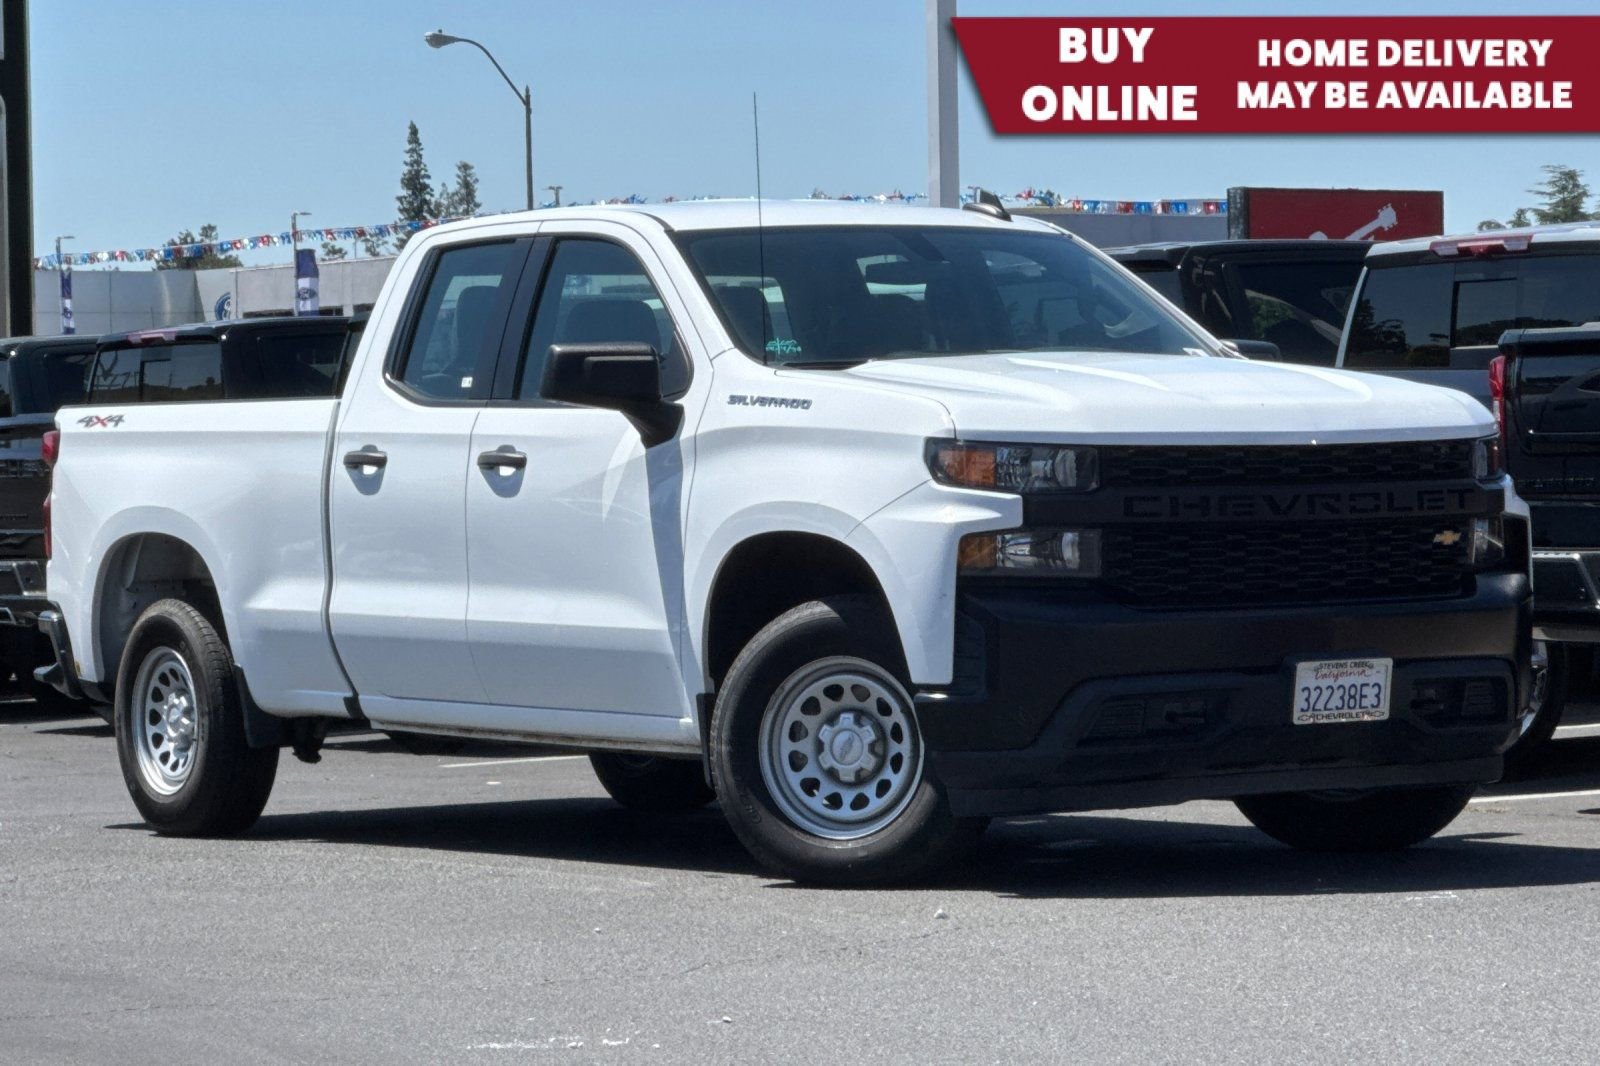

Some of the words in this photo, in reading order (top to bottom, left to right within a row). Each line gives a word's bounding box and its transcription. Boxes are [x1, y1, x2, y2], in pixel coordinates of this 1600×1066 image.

[727, 394, 813, 410] SILVERADO
[1123, 488, 1475, 517] CHEVROLET
[1318, 661, 1348, 670] STEVENS
[1314, 668, 1370, 682] California
[1300, 682, 1382, 712] 32238E3
